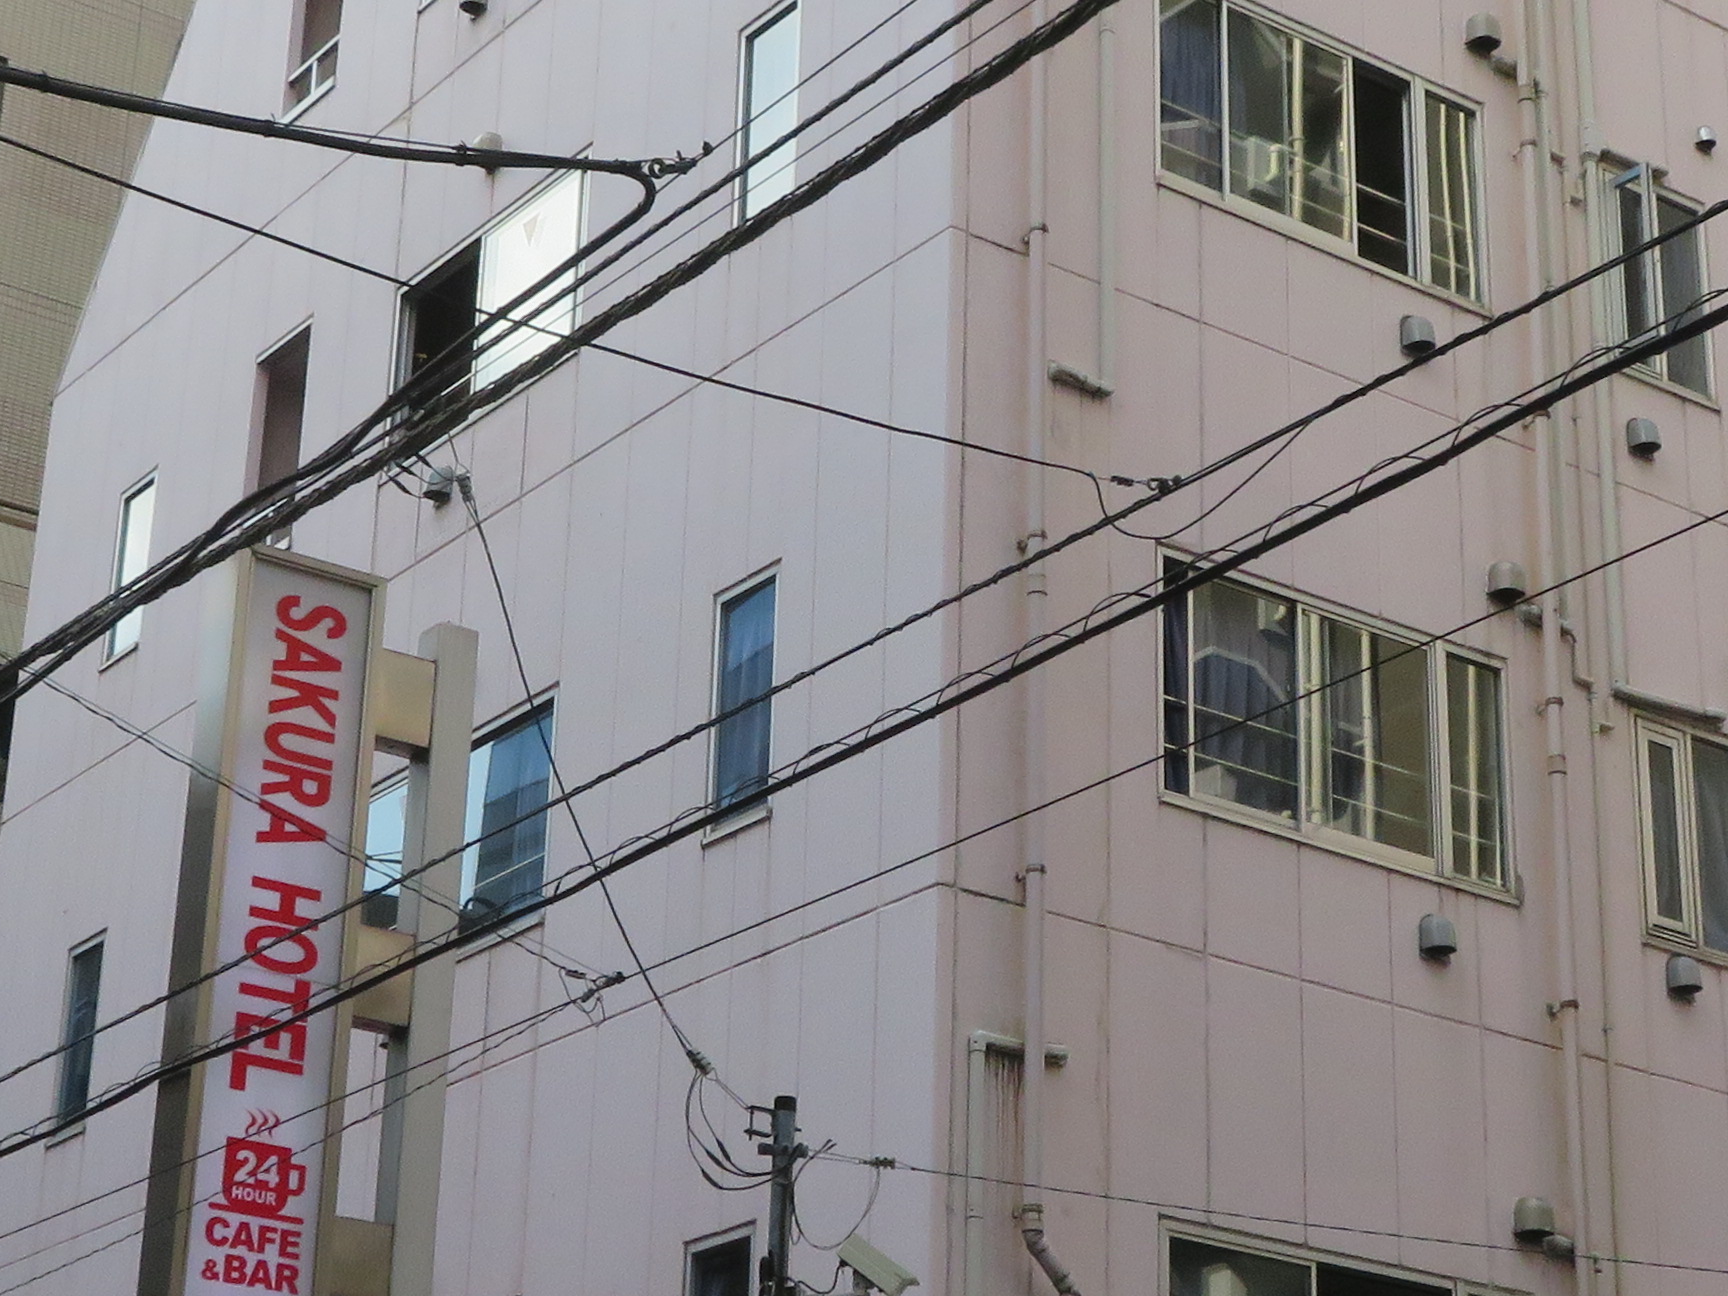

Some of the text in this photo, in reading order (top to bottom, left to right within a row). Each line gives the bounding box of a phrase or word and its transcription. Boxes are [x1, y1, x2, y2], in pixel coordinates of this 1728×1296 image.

[228, 593, 348, 1092] SAKURA HOTEL
[233, 1150, 280, 1189] 24
[231, 1185, 277, 1206] HOUR
[204, 1216, 303, 1261] CAFE
[201, 1254, 300, 1296] &BAR
